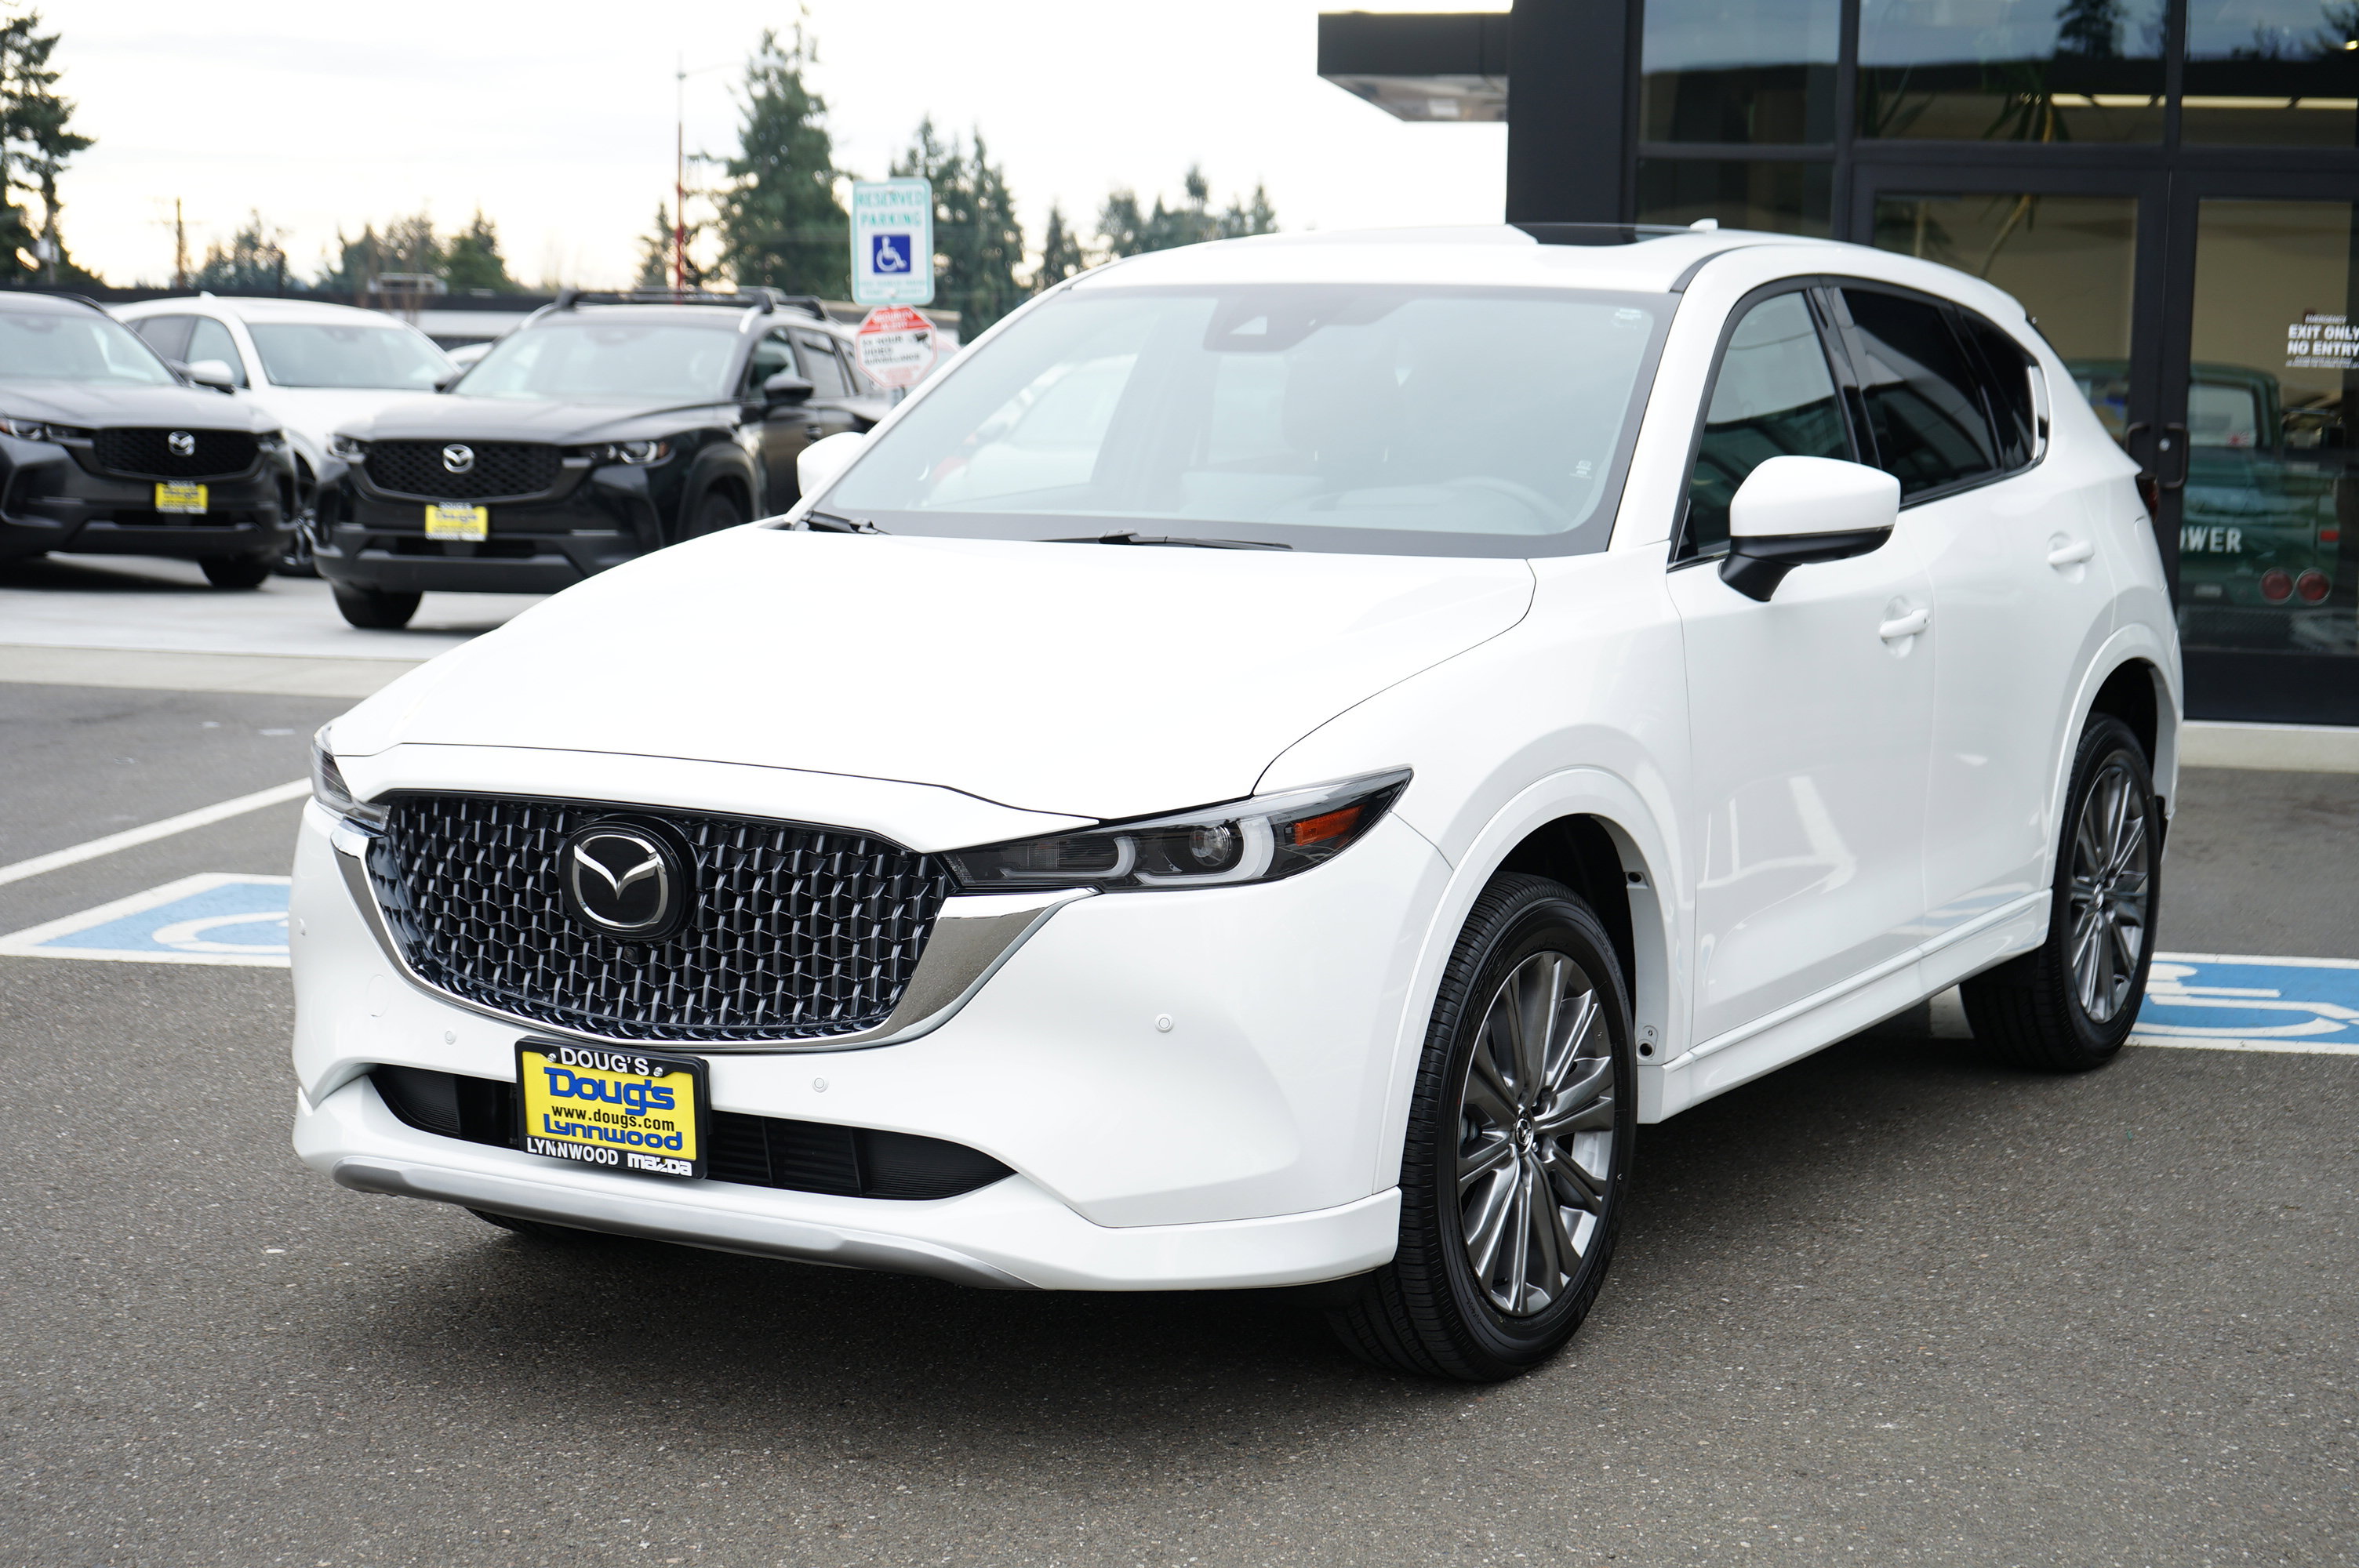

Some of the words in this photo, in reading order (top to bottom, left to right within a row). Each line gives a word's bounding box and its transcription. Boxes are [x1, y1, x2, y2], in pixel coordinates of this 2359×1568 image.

[856, 192, 922, 207] RESERVED
[860, 212, 922, 227] PARKING
[2288, 323, 2321, 339] EXIT
[2324, 325, 2359, 340] ONLY
[2287, 340, 2310, 356] NO
[2313, 341, 2359, 357] ENTRY
[560, 1047, 649, 1076] DOUG'S
[551, 1105, 674, 1131] www.dougs.com
[543, 1113, 683, 1151] Lynnwood
[527, 1137, 619, 1166] LYNNWOOD
